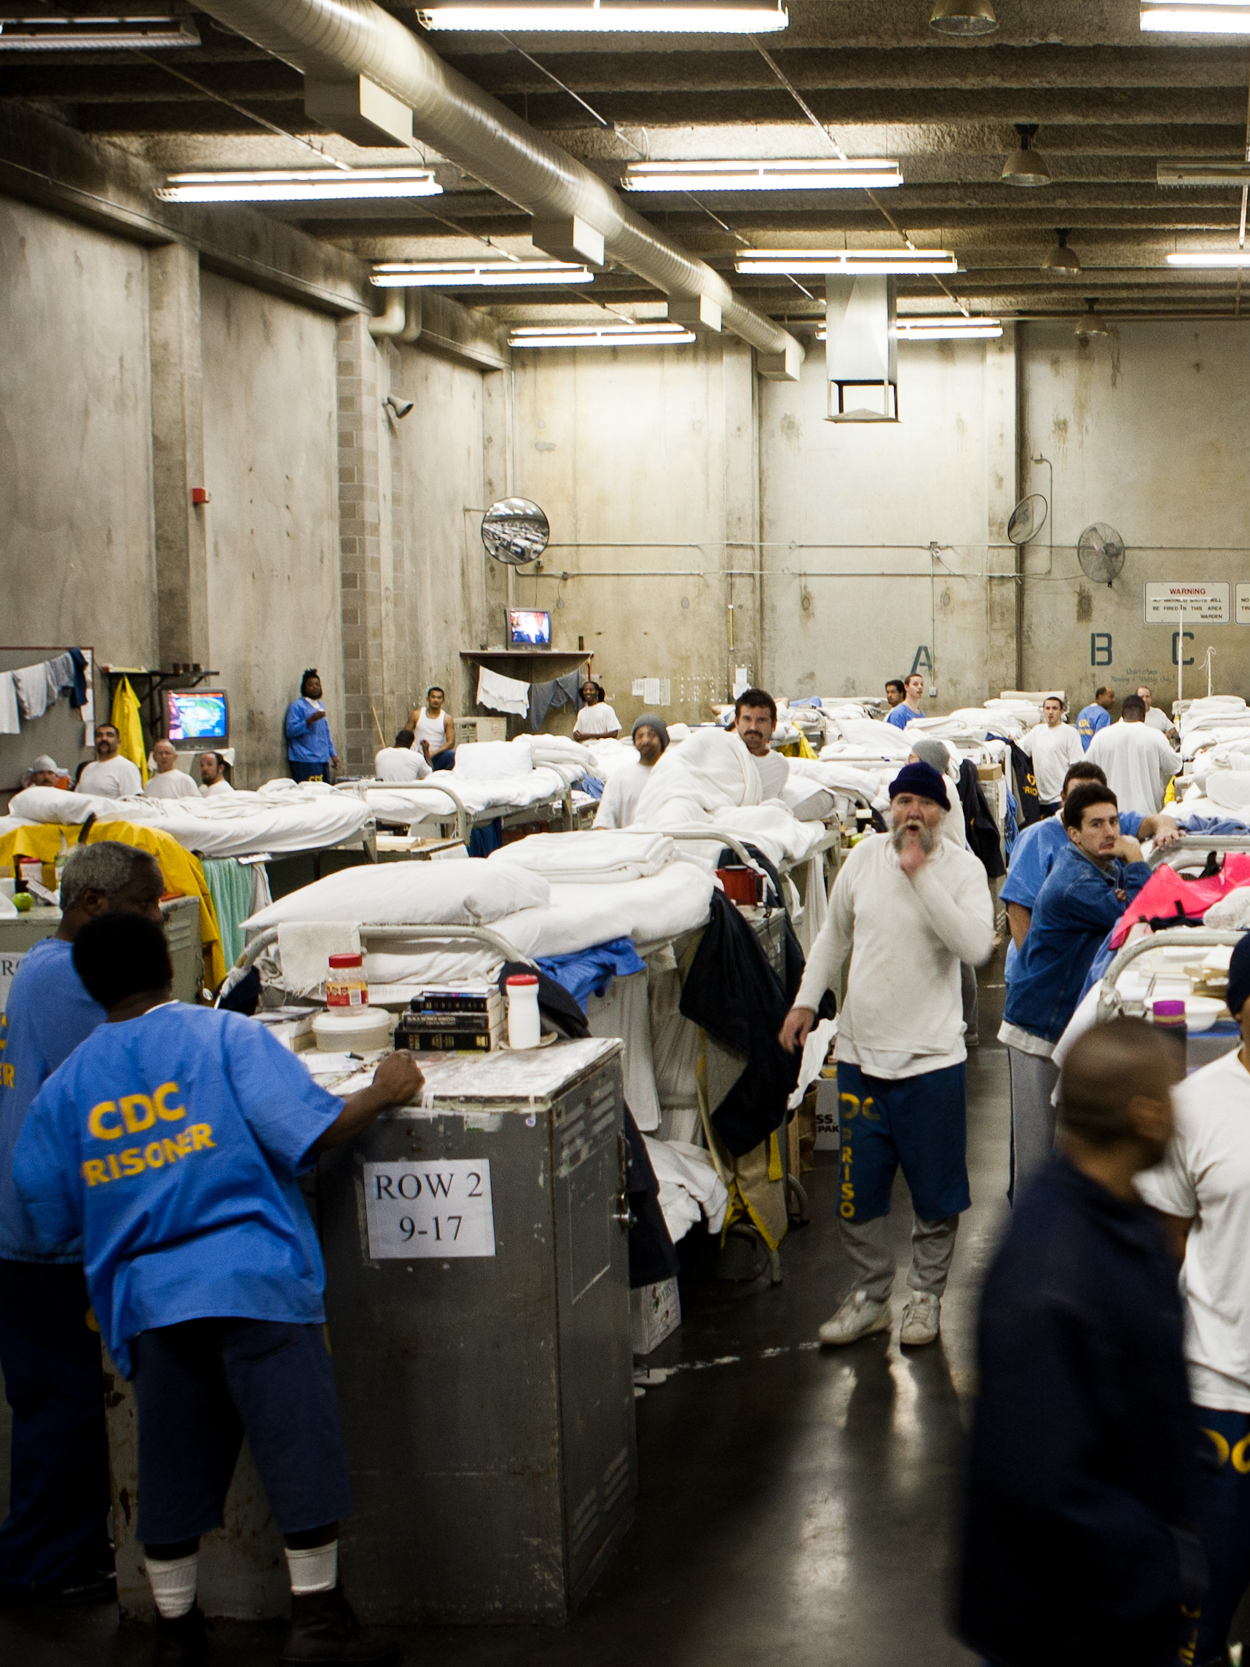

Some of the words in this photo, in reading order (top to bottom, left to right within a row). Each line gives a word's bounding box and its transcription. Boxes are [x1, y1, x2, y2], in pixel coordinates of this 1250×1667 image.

[1169, 587, 1206, 595] WARNING
[910, 645, 932, 675] A
[1090, 632, 1113, 666] B
[1171, 632, 1194, 666] C
[87, 1081, 187, 1140] CDC
[375, 1173, 455, 1200] ROW
[466, 1172, 484, 1198] 2
[399, 1215, 463, 1242] 9-17
